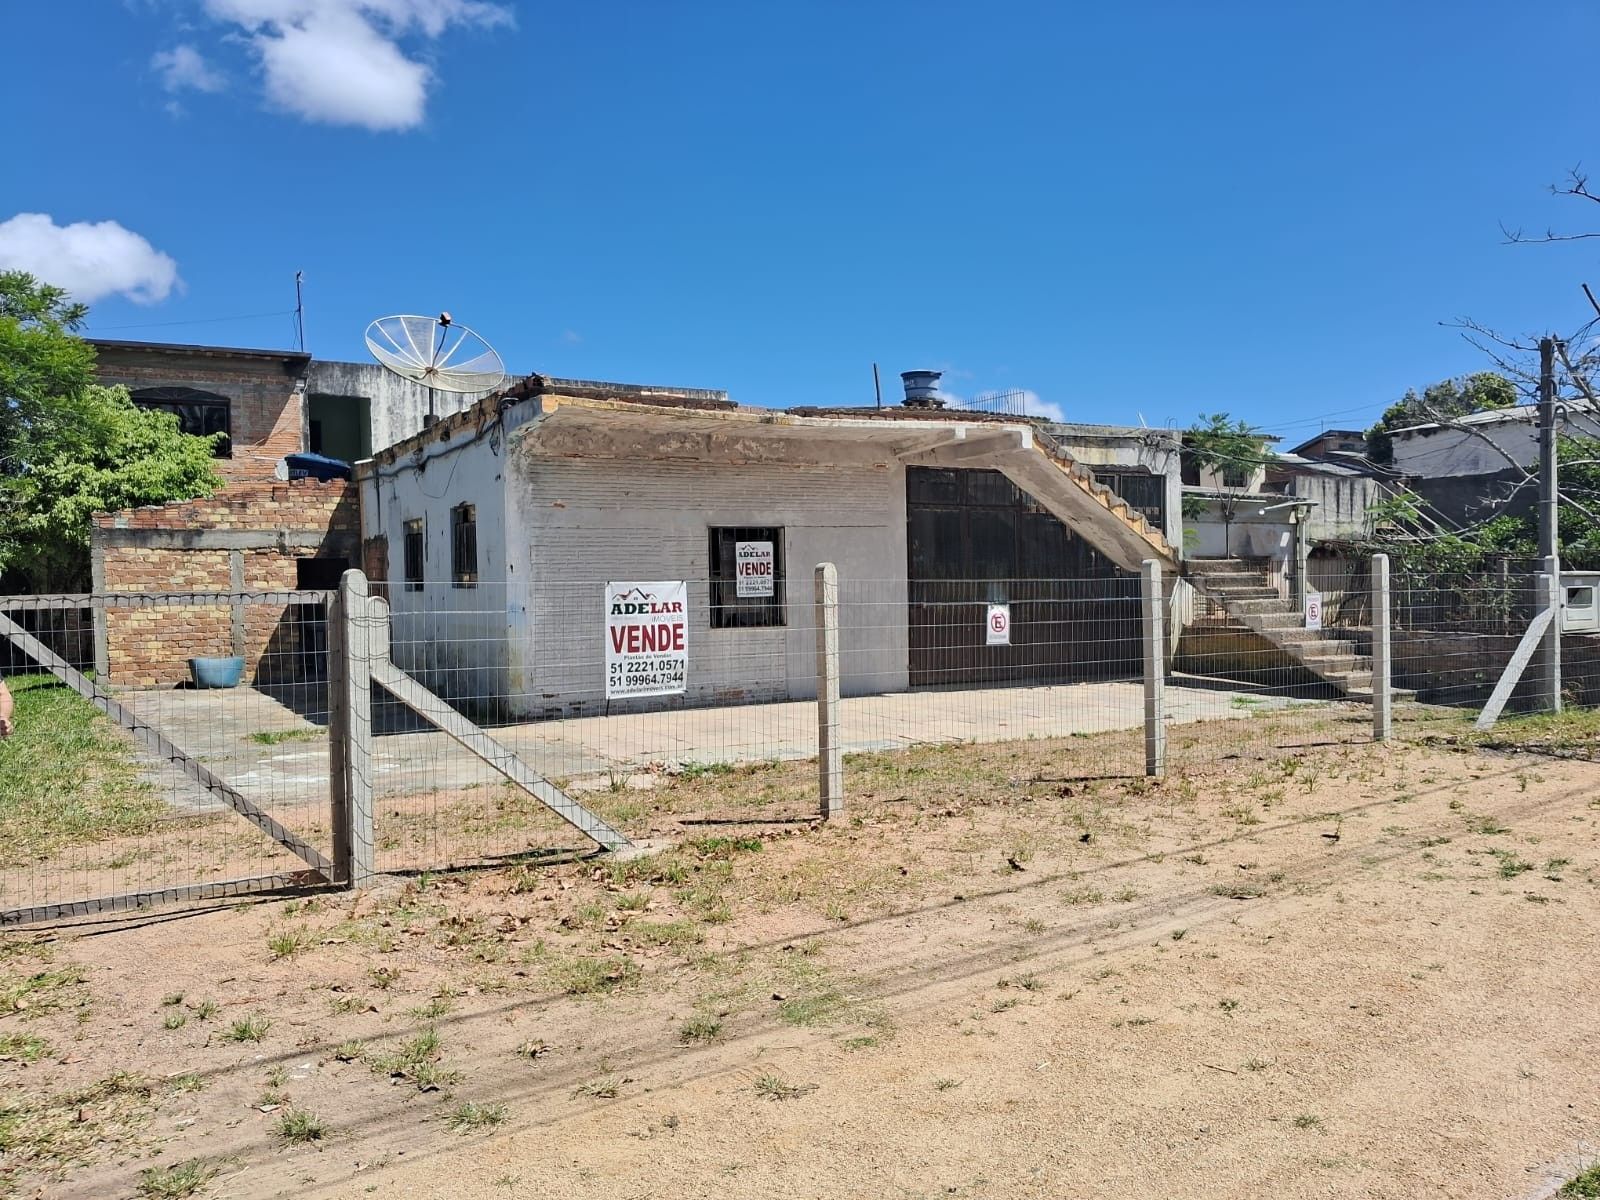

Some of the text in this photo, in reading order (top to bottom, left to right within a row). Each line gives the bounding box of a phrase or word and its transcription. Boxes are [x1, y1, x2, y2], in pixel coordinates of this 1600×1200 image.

[738, 562, 771, 576] VENDE
[611, 602, 682, 615] ADELAR
[610, 623, 685, 653] VENDE
[610, 659, 685, 673] 51 2221.0571
[610, 671, 684, 687] 51 99964.7944
